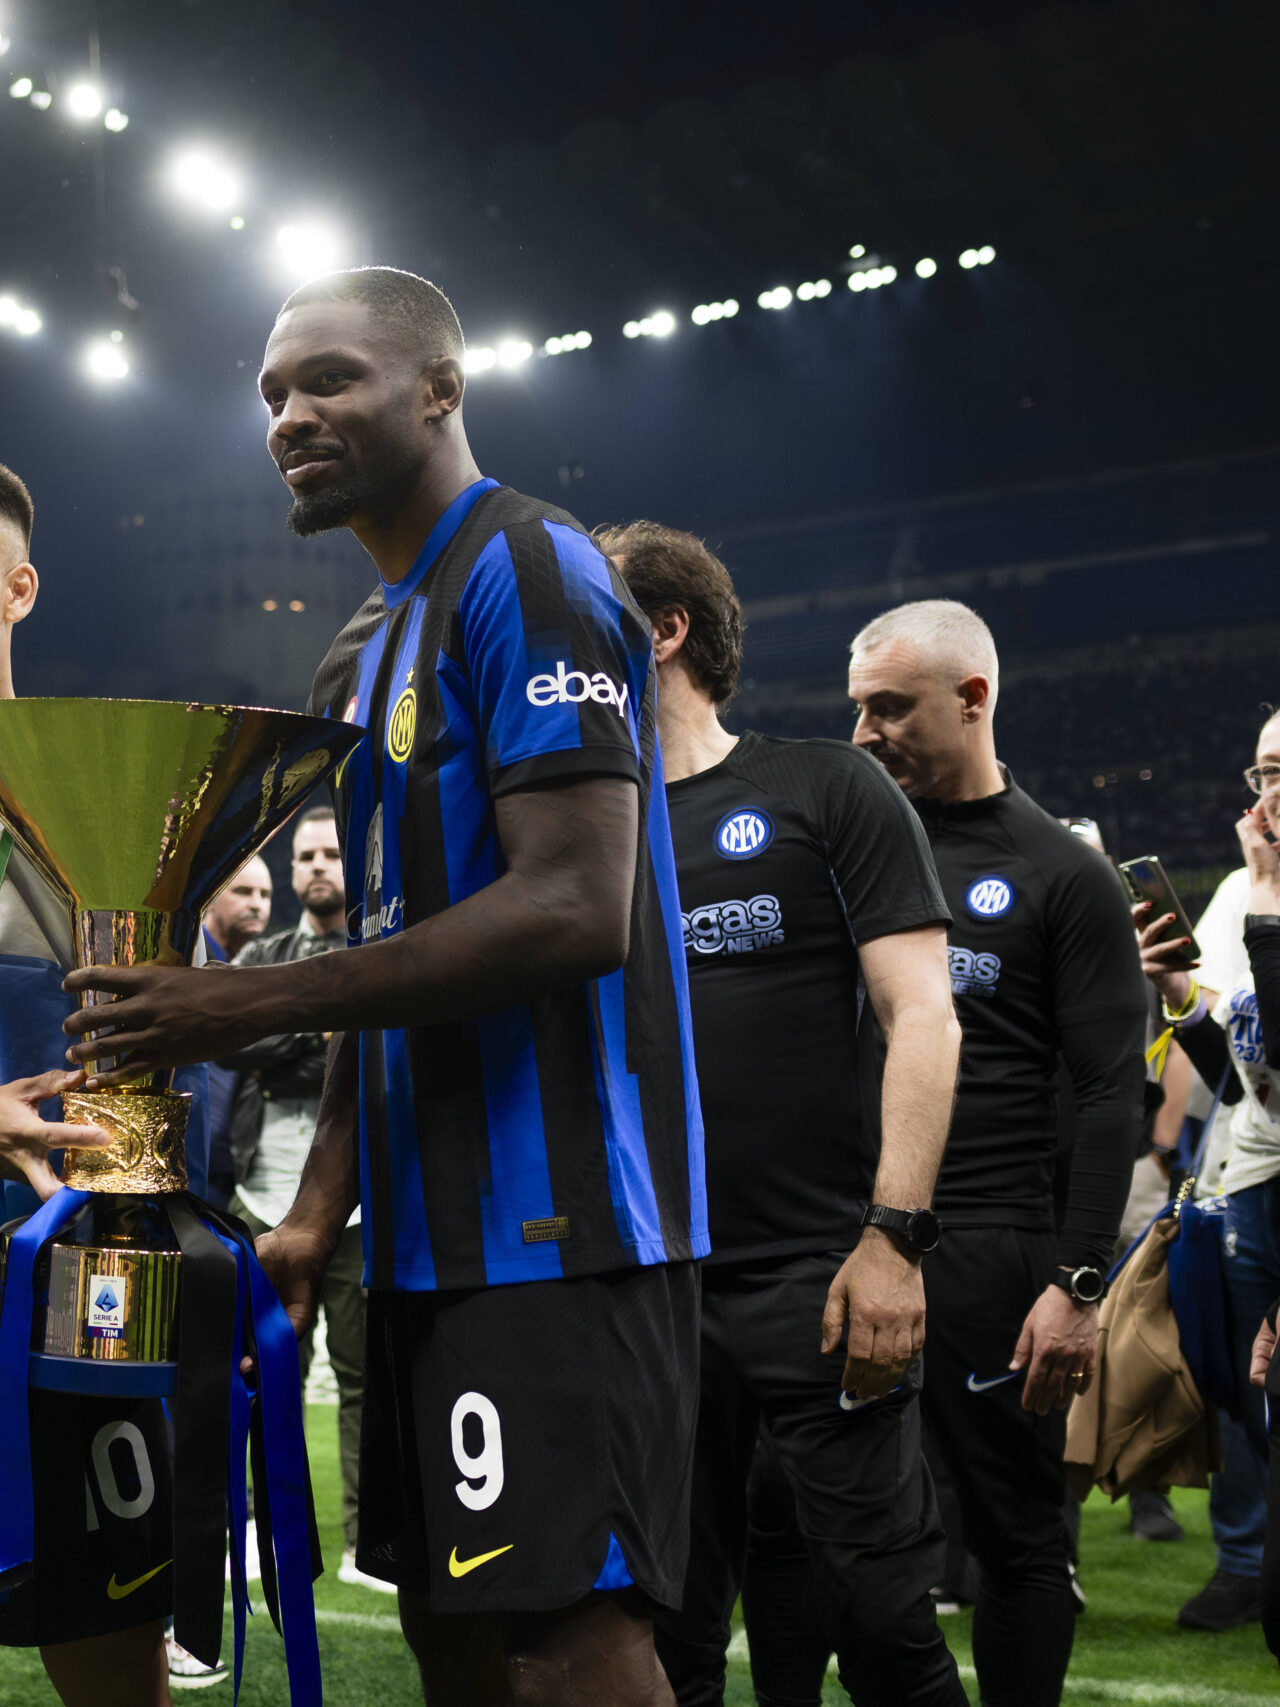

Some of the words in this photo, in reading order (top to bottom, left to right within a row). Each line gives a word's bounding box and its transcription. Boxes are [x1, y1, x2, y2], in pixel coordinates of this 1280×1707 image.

[526, 661, 628, 717] ebay
[102, 1328, 119, 1338] TIM
[451, 1391, 504, 1511] 9
